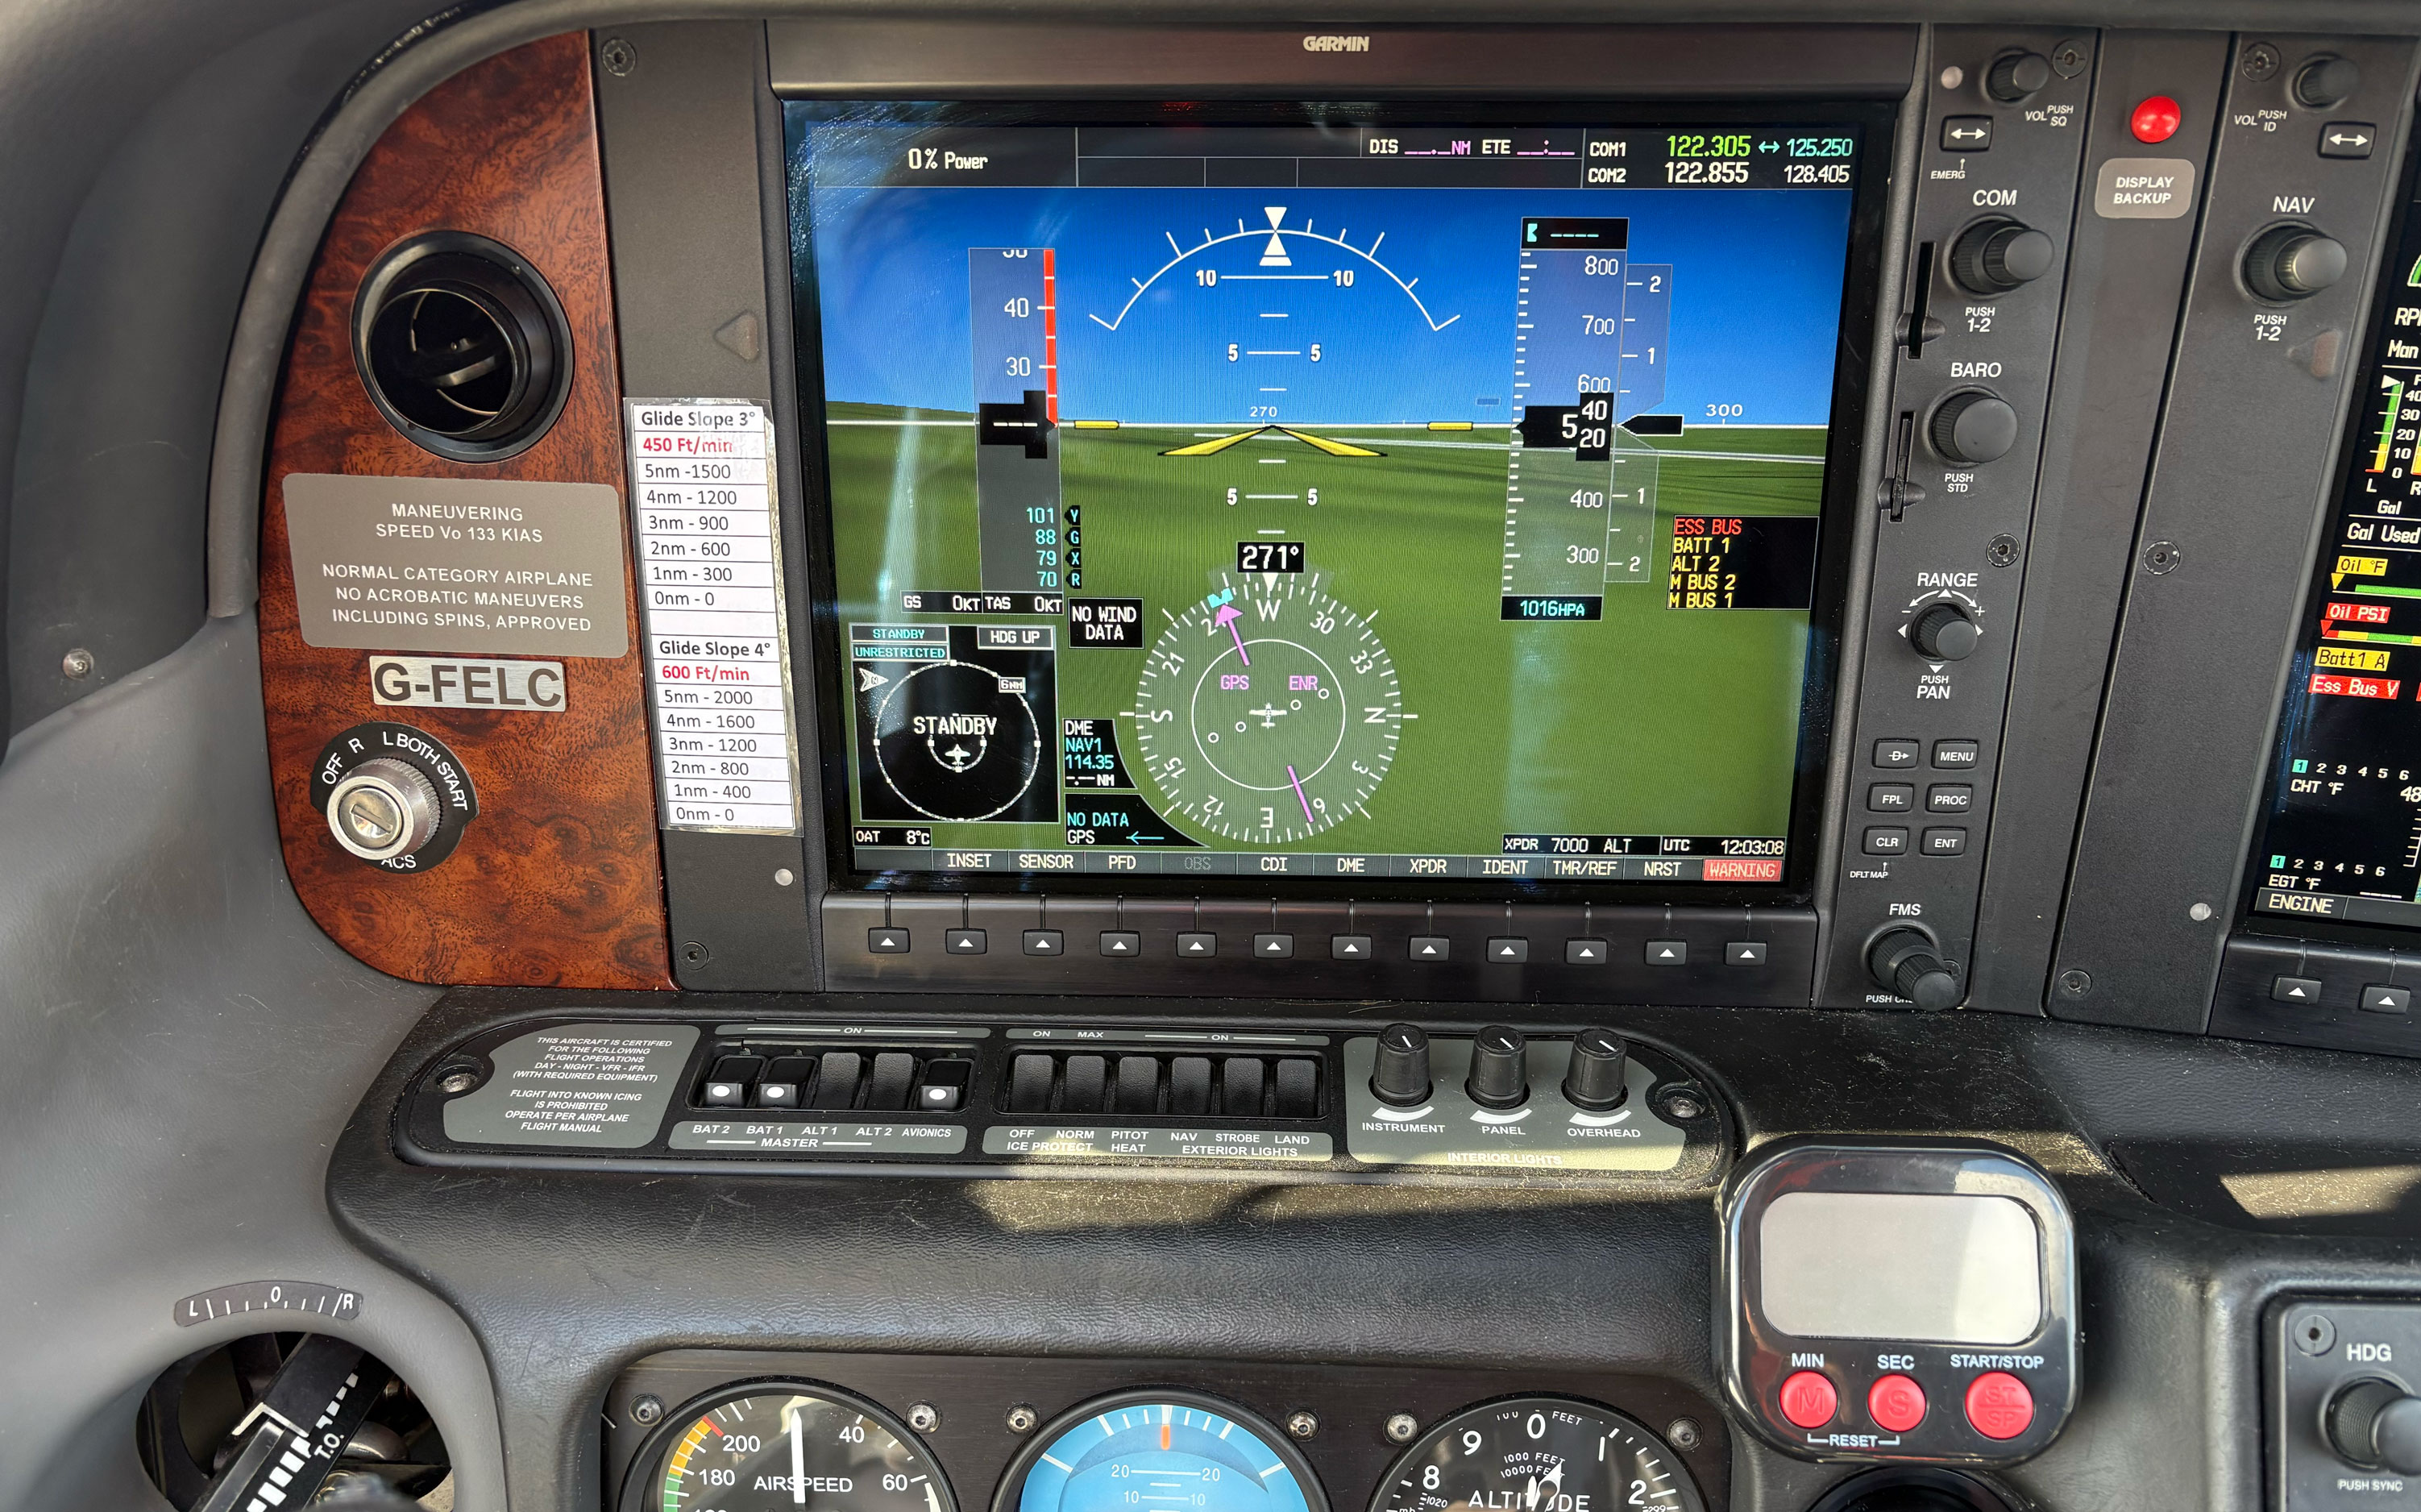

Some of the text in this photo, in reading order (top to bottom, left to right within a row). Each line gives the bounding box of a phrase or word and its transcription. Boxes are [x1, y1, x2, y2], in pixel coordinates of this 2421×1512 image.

[1303, 35, 1369, 52] GARMIN
[2024, 111, 2048, 122] VOL
[2047, 106, 2074, 114] PUSH
[2050, 116, 2067, 127] SQ
[1369, 139, 1398, 155] DIS
[1482, 139, 1511, 155] ETE
[1589, 135, 1853, 157] COM1 122.305 125.250
[908, 147, 988, 170] 0% Power
[1588, 162, 1850, 184] COM2 122.855 128.405
[1930, 171, 1966, 179] EMERG
[2116, 177, 2174, 189] DISPLAY
[1973, 189, 2017, 206] COM
[2113, 193, 2171, 204] BACKUP
[2273, 196, 2315, 214] NAV
[1965, 307, 1995, 317] PUSH
[1967, 318, 1991, 332] 1-2
[2387, 340, 2419, 359] Man
[1951, 362, 2002, 377] BARO
[642, 411, 683, 426] Glide
[688, 412, 733, 429] Slope
[643, 436, 733, 455] 450 Ft/min
[646, 463, 679, 478] 5nm
[1945, 473, 1974, 483] PUSH
[1947, 484, 1968, 492] STD
[392, 504, 522, 521] MANEUVERING
[376, 524, 434, 539] SPEED
[467, 527, 495, 541] 133
[502, 529, 542, 542] KIAS
[1675, 518, 1742, 535] ESS BUS
[2347, 522, 2421, 544] Gal Used
[323, 564, 592, 587] NORMAL CATEGORY AIRPLANE
[1917, 572, 1978, 587] RANGE
[336, 587, 583, 609] NO ACROBATIC MANEUVERS
[1073, 606, 1136, 623] NO WIND
[2330, 604, 2388, 621] Oil PSI
[333, 609, 591, 632] INCLUDING SPINS, APPROVED
[873, 629, 925, 640] STANDBY
[990, 630, 1040, 644] HDG UP
[1086, 624, 1123, 640] DATA
[660, 641, 700, 654] Glide
[706, 642, 750, 658] Slope
[855, 646, 945, 658] UNRESTRICTED
[662, 666, 750, 682] 600 Ft/min
[1921, 675, 1950, 684] PUSH
[374, 663, 561, 707] G-FELC
[1220, 675, 1249, 690] GPS
[1289, 675, 1318, 691] ENR
[1916, 685, 1951, 700] PAN
[913, 716, 998, 736] STANDBY
[1065, 721, 1094, 736] DME
[397, 733, 441, 765] BOTH
[1066, 737, 1102, 753] NAV1
[1065, 754, 1115, 770] 114.35
[1940, 751, 1974, 762] MENU
[322, 752, 343, 784] OFF
[438, 761, 467, 811] START
[2290, 779, 2321, 793] CHT
[1883, 795, 1904, 804] FPL
[1935, 795, 1967, 805] PROC
[1067, 812, 1129, 827] NO DATA
[1504, 838, 1632, 853] XPDR 7000 ALT
[1663, 839, 1784, 854] UTC 12:03:08
[1876, 837, 1899, 847] CLR
[1935, 839, 1958, 848] ENT
[947, 854, 992, 868] INSET
[1019, 854, 1074, 869] SENSOR
[1108, 856, 1136, 870] PFD
[1261, 858, 1288, 871] CDI
[1410, 859, 1447, 873] XPDR
[1483, 859, 1529, 874] IDENT
[1554, 860, 1617, 875] TMR/REF
[1643, 862, 1682, 877] NRST
[1710, 862, 1775, 878] WARNING
[1889, 903, 1921, 916] FMS
[2269, 894, 2334, 914] ENGINE
[844, 1027, 862, 1035] ON
[574, 1092, 612, 1100] KNOWN
[614, 1093, 642, 1101] ICING
[547, 1102, 608, 1110] PROHIBITED
[521, 1122, 602, 1132] FLIGHT MANUAL
[692, 1126, 730, 1134] BAT 2
[856, 1128, 892, 1136] ALT 2
[902, 1128, 951, 1137] AVIONICS
[1009, 1129, 1036, 1139] OFF
[1362, 1122, 1445, 1133] INSTRUMENT
[1481, 1125, 1526, 1136] PANEL
[1567, 1128, 1641, 1138] OVERHEAD
[761, 1138, 819, 1147] MASTER
[1056, 1130, 1094, 1140] NORM
[1111, 1130, 1148, 1140] PITOT
[1170, 1132, 1198, 1141] NAV
[1215, 1133, 1260, 1144] STROBE
[1275, 1135, 1310, 1144] LAND
[1007, 1142, 1093, 1153] ICE PROTECT
[1111, 1144, 1146, 1153] HEAT
[1181, 1146, 1298, 1157] EXTERIOR LIGHTS
[1447, 1153, 1563, 1165] INTERIOR LIGHTS
[2347, 1343, 2392, 1361] HDG
[1791, 1353, 1825, 1368] MIN
[1877, 1355, 1915, 1369] SEC
[1950, 1354, 2044, 1369] START/STOP
[1552, 1410, 1583, 1425] FEET
[723, 1435, 761, 1452] 200
[1829, 1435, 1879, 1447] RESET
[1503, 1452, 1566, 1465] 1000 FEET
[754, 1476, 853, 1493] AIRSPEED
[882, 1474, 908, 1491] 60
[2338, 1479, 2403, 1491] PUSH SYNC
[1468, 1489, 1590, 1510] ALTIDE
